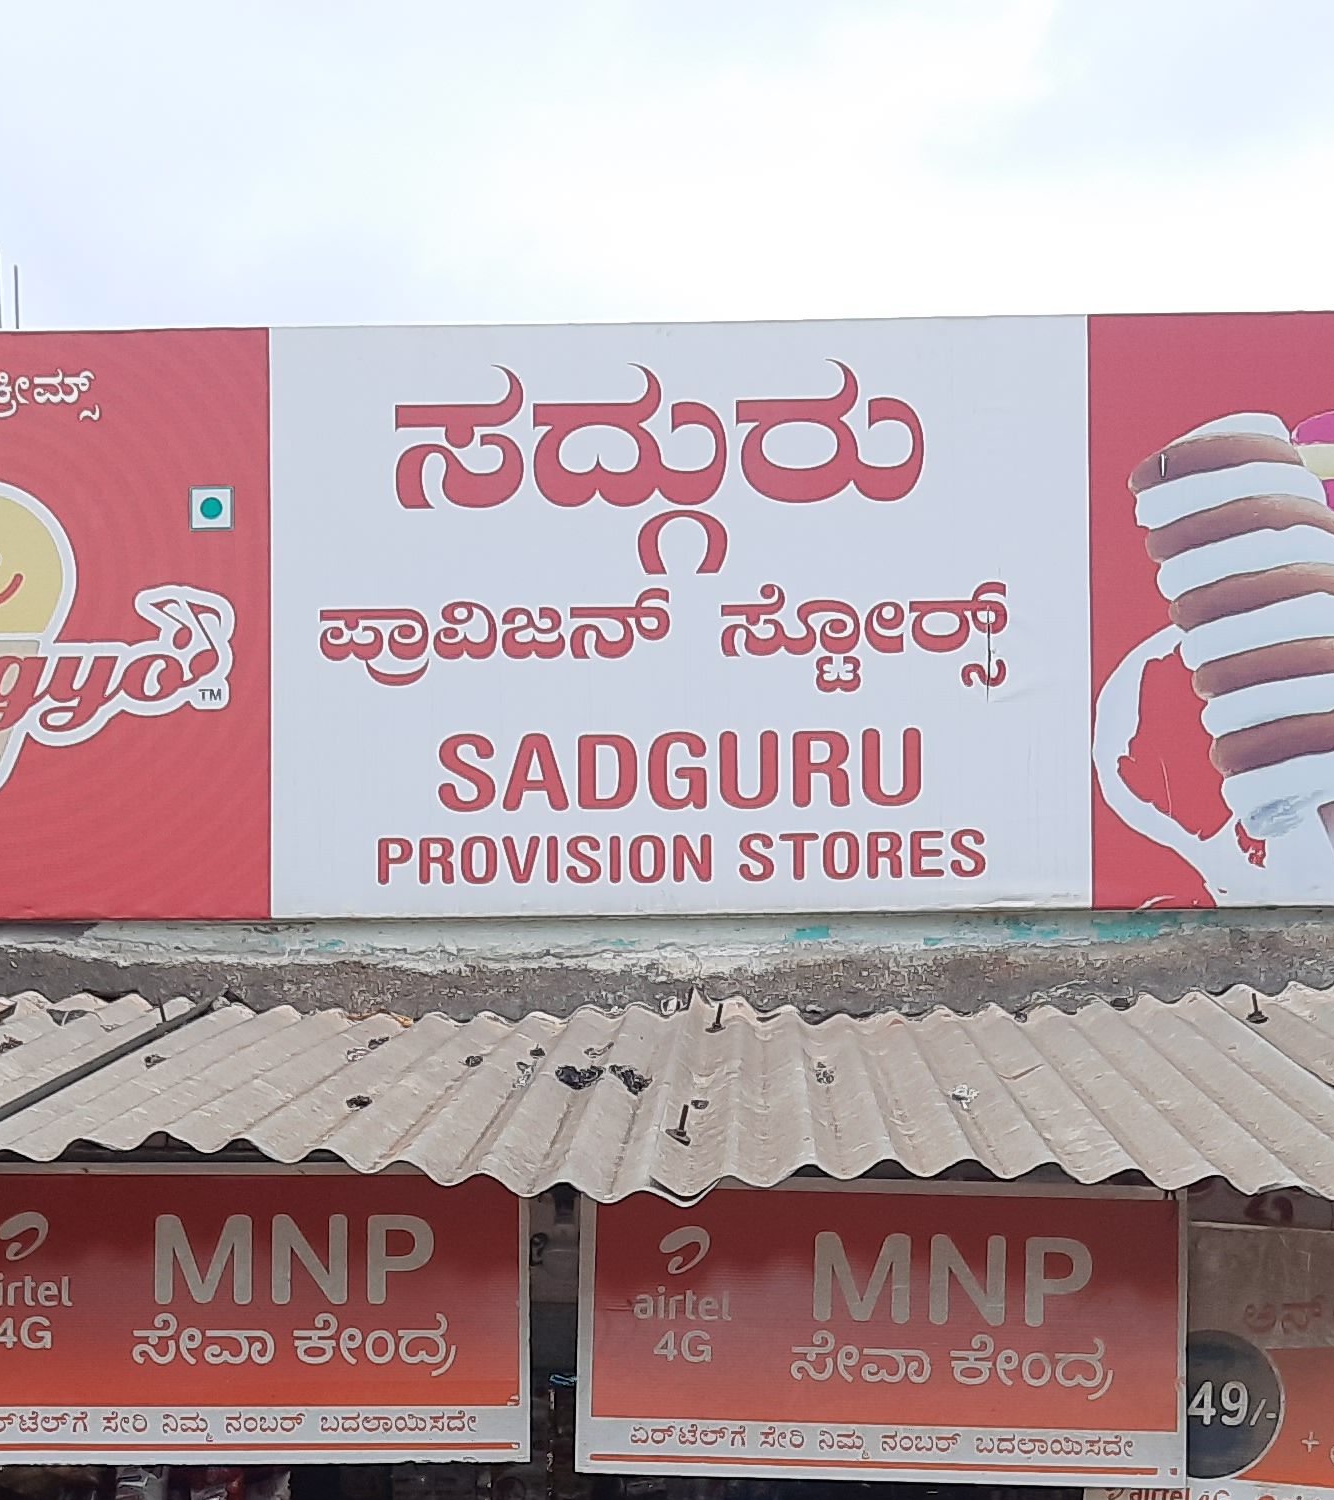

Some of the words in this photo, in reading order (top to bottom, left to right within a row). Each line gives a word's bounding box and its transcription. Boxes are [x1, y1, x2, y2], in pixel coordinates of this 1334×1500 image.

[394, 358, 925, 575] ಸದ್ಗುರು
[319, 587, 671, 687] ಪ್ರಾವಿಜನ್
[437, 727, 923, 813] SADGURU
[376, 834, 713, 886] PROVISION
[737, 828, 988, 881] STORES
[152, 1213, 435, 1305] MNP
[811, 1231, 1093, 1327] MNP
[632, 1287, 731, 1322] airtel
[130, 1312, 276, 1366] ಸೇವಾ
[293, 1312, 457, 1377] ಕೇಂದ್ರ
[653, 1331, 713, 1363] 4G
[789, 1330, 932, 1385] ಸೇವಾ
[949, 1334, 1114, 1400] ಕೇಂದ್ರ
[102, 1410, 149, 1435] ಸೇರಿ
[161, 1412, 213, 1442] ನಿಮ್ಮ
[225, 1410, 305, 1435] ನಂಬರ್
[319, 1410, 478, 1438] ಬದಲಾಯಿಸದೇ
[759, 1424, 806, 1452] ಸೇರಿ
[818, 1427, 870, 1459] ನಿಮ್ಮ
[881, 1429, 961, 1455] ನಂಬರ್
[975, 1432, 1134, 1459] ಬದಲಾಯಿಸದೇ
